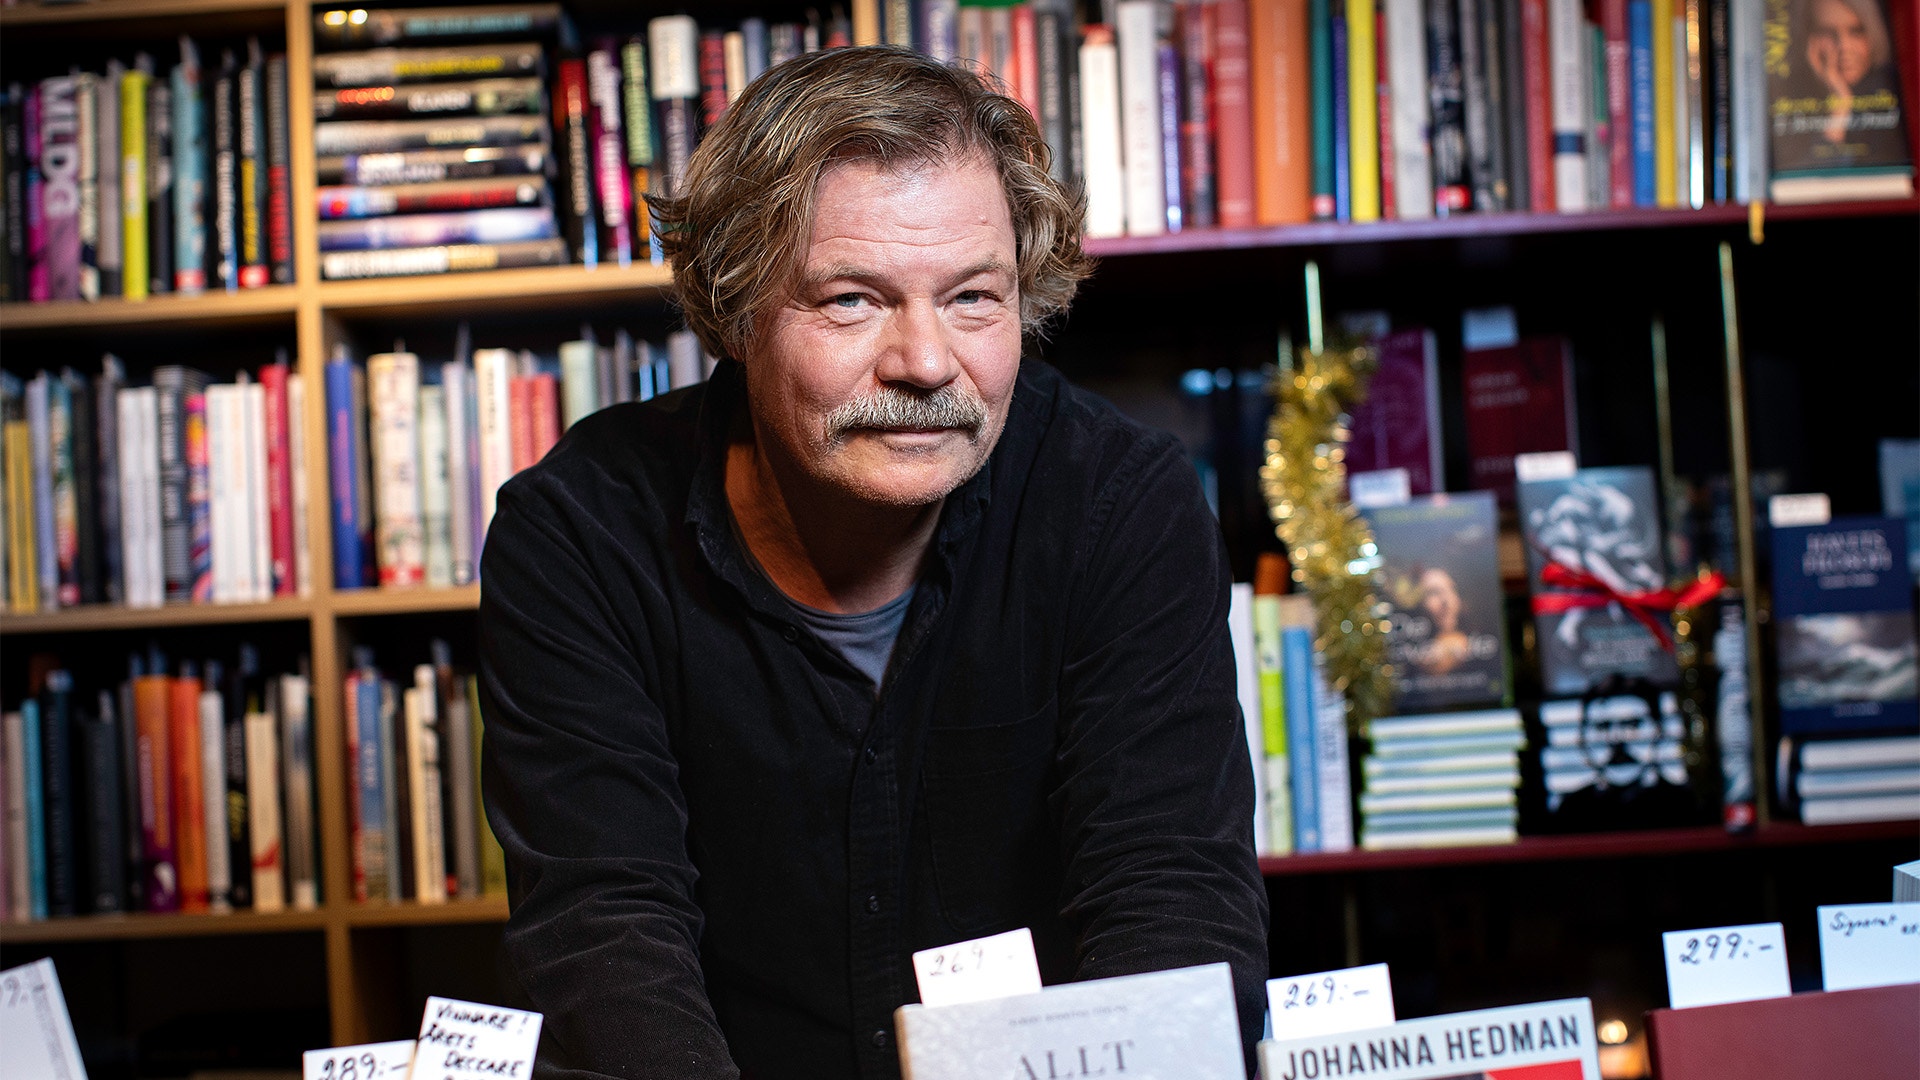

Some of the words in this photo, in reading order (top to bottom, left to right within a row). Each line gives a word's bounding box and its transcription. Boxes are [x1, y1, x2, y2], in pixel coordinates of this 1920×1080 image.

[1679, 933, 1773, 964] 299:-
[1283, 977, 1369, 1009] 269:-
[1012, 1039, 1135, 1080] ALLT
[1283, 1034, 1434, 1080] JOHANNA
[1446, 1015, 1580, 1063] HEDMAN
[318, 1052, 409, 1080] 289:-
